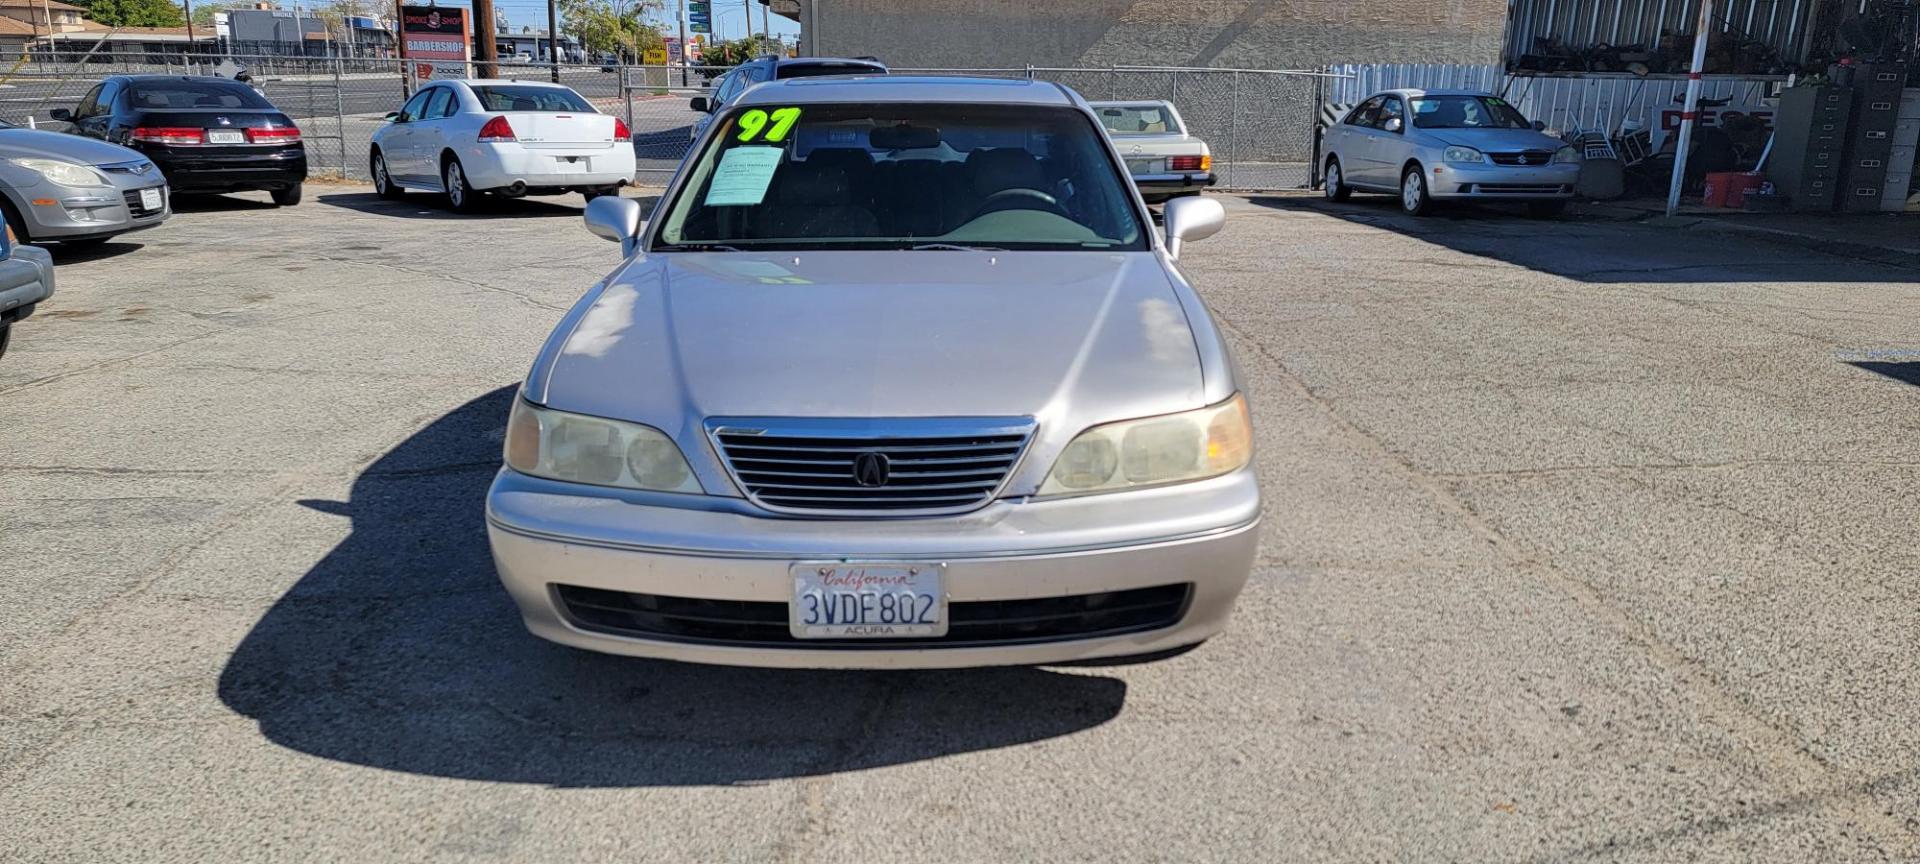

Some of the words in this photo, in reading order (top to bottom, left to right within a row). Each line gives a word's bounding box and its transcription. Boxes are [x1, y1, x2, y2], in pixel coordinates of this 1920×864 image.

[405, 15, 427, 24] SMOKE
[441, 17, 463, 25] SHOP
[407, 40, 464, 52] BARBERSHOP
[437, 66, 464, 75] boost
[738, 107, 802, 142] 97
[824, 568, 916, 592] California
[803, 593, 936, 625] 3VDF802
[844, 626, 895, 635] ACURA
